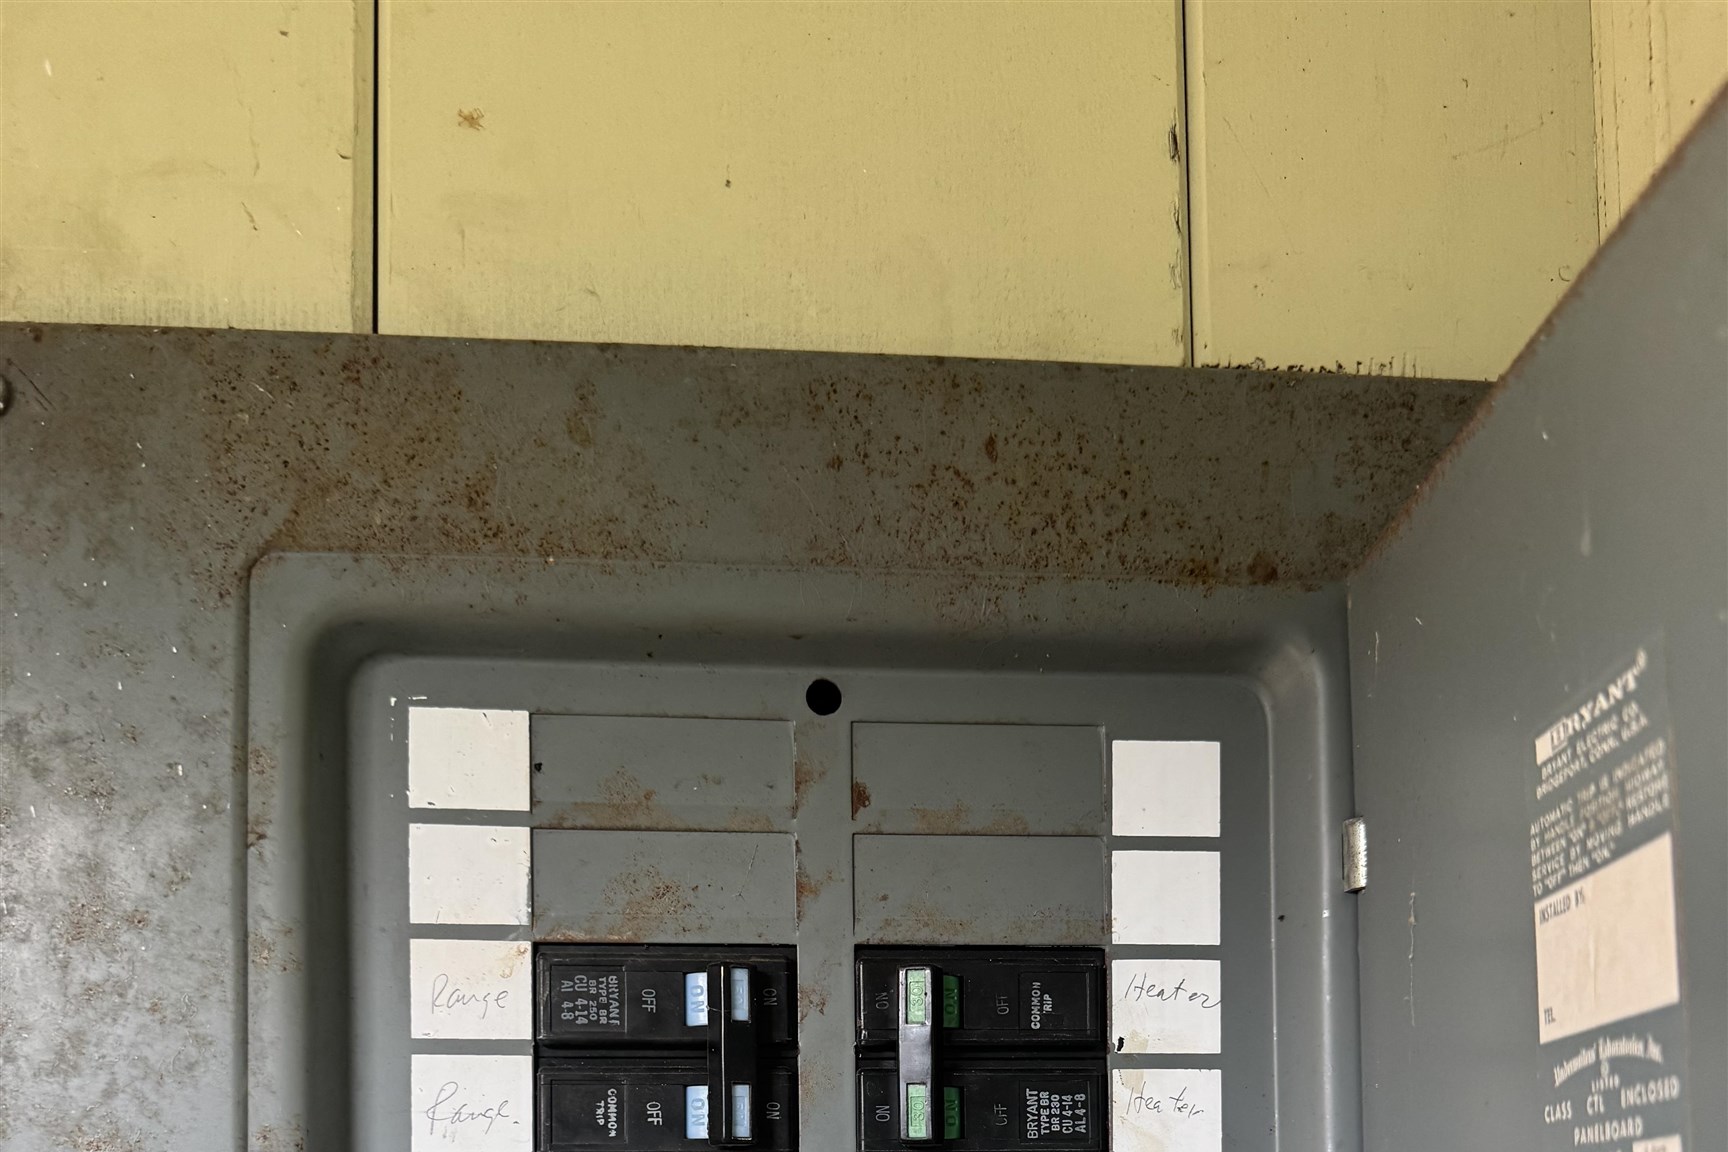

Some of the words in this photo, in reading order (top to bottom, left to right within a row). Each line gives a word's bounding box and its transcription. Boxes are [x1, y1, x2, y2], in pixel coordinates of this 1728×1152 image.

[1539, 897, 1571, 925] INSTALLED
[432, 973, 509, 1019] Range
[608, 975, 620, 1025] BRYANT
[642, 989, 656, 1013] OFF
[690, 985, 705, 1014] ON
[764, 988, 777, 1006] ON
[1124, 973, 1221, 1009] Heater
[1031, 982, 1041, 1030] COMMON
[767, 1102, 780, 1120] ON
[1051, 1094, 1060, 1115] 230
[1061, 1094, 1073, 1116] 4-14
[1074, 1094, 1086, 1115] 4-8
[1127, 1082, 1204, 1115] Heater
[1544, 1101, 1572, 1124] CLASS
[1587, 1094, 1604, 1115] CTL
[1620, 1075, 1680, 1109] ENCLOSED
[596, 1101, 605, 1126] TRIP
[608, 1088, 618, 1137] COMMON
[647, 1102, 662, 1126] OFF
[875, 1105, 890, 1122] ON
[1026, 1089, 1039, 1139] BRYANT
[1051, 1116, 1060, 1131] BR
[1062, 1119, 1073, 1133] CU
[1074, 1118, 1086, 1133] AL
[1574, 1115, 1643, 1146] PANELBOARD
